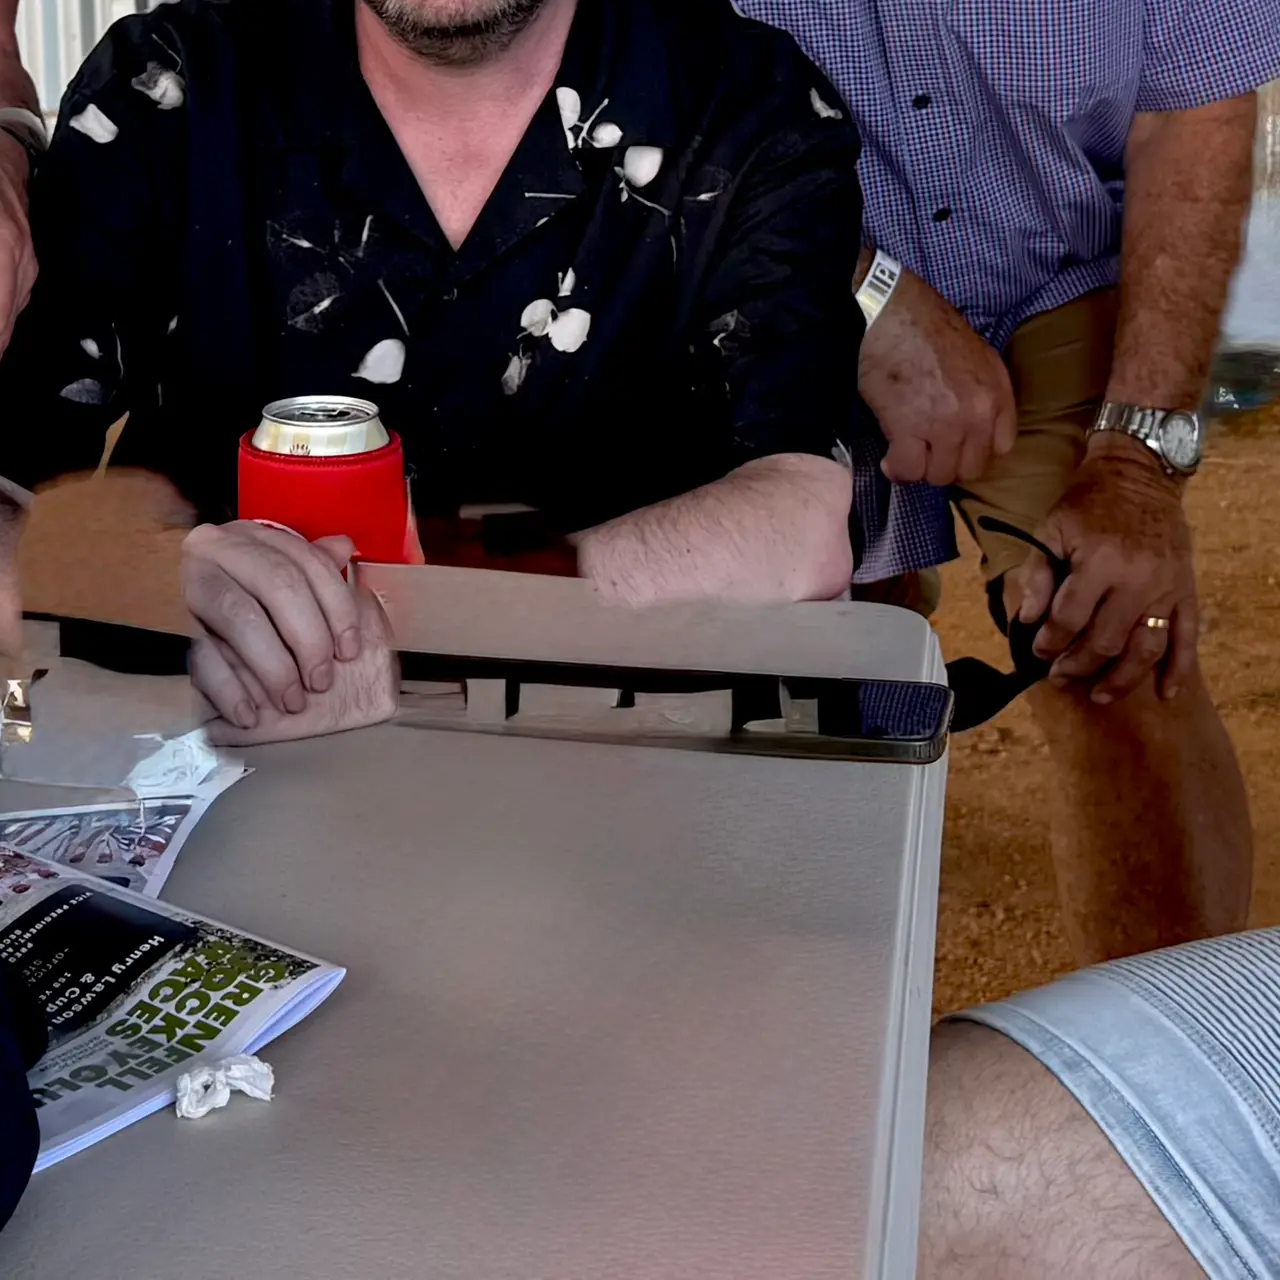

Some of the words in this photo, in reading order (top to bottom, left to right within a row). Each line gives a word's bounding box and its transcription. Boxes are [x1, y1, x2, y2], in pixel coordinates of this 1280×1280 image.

[70, 891, 93, 905] VICE
[111, 935, 165, 975] Henry
[79, 972, 96, 985] &
[105, 939, 233, 1041] RACES
[45, 986, 80, 1013] Cup
[51, 975, 116, 1025] Lawson
[95, 962, 287, 1092] GRENFELL
